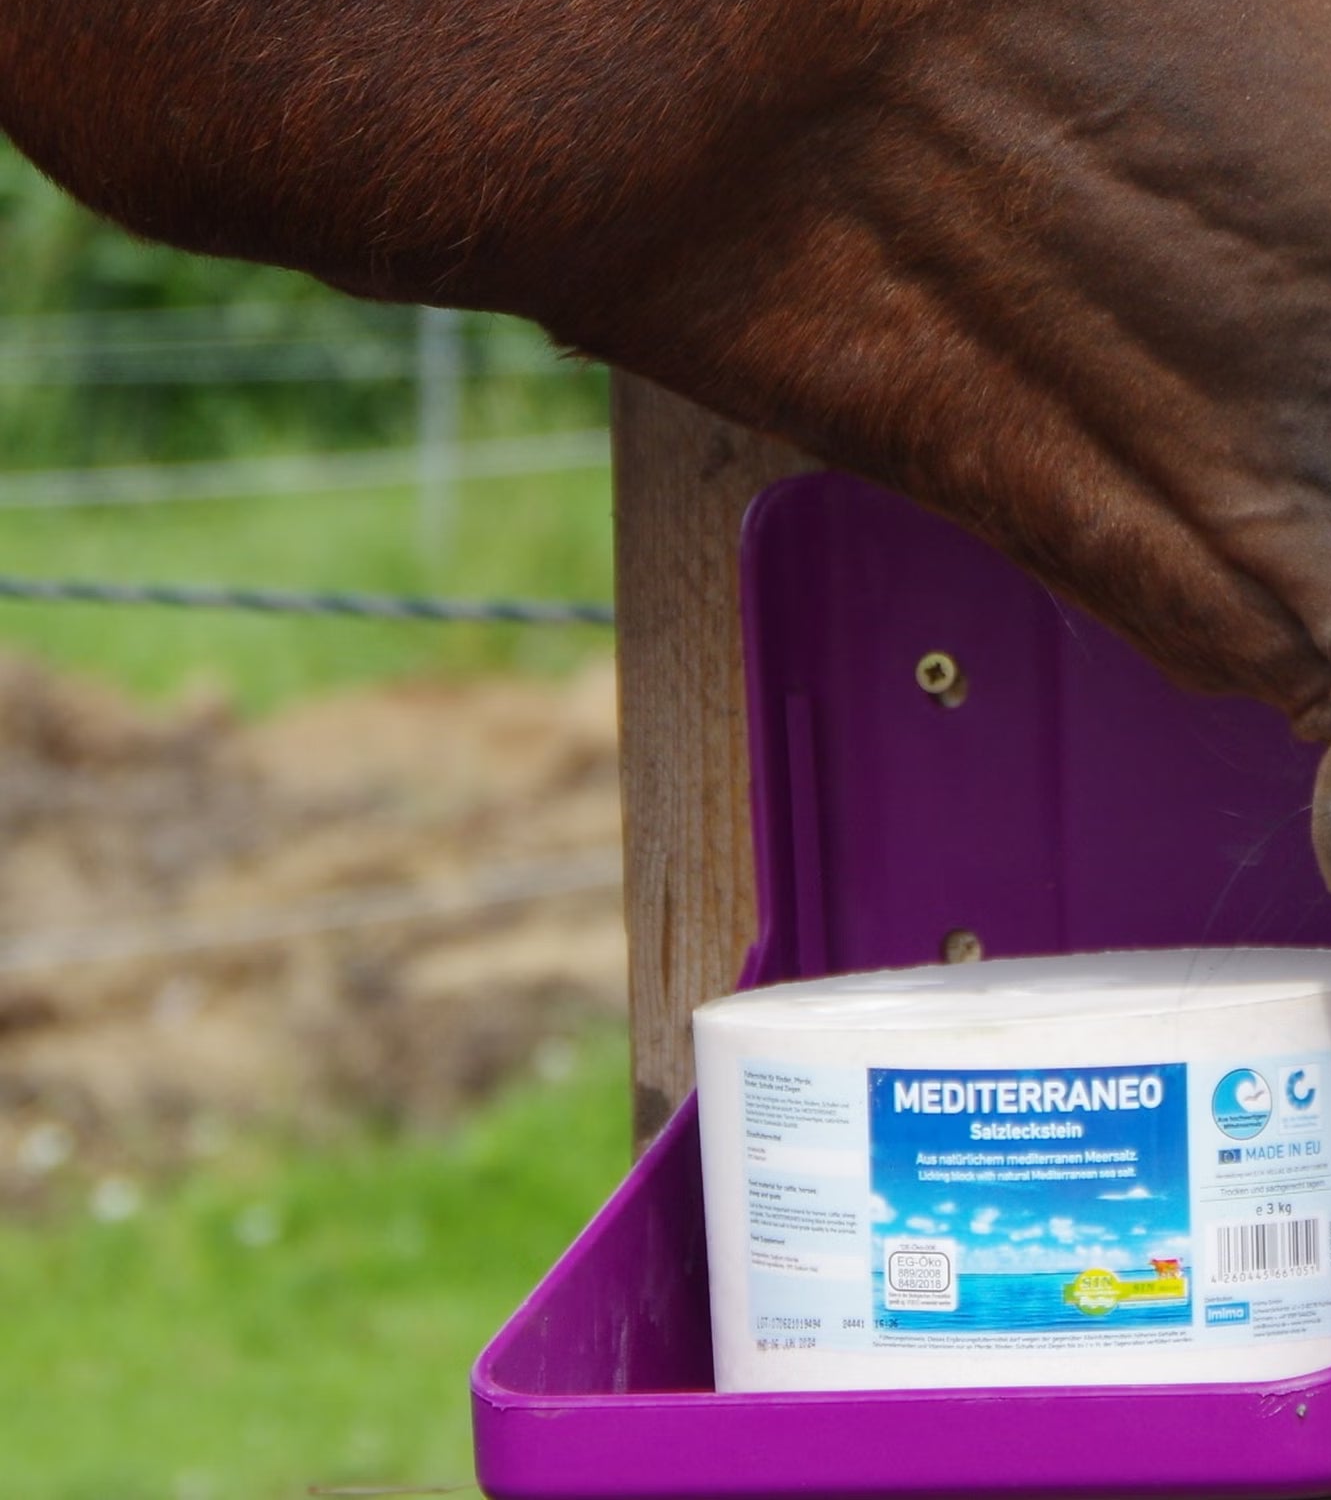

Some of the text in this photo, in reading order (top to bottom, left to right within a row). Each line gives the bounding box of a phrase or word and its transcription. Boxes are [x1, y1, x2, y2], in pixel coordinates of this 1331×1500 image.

[893, 1078, 1162, 1115] MEDITERRANEO
[970, 1121, 1083, 1141] Salzleckstein
[915, 1152, 937, 1166] Aus
[1006, 1151, 1083, 1166] mediterranen
[1084, 1150, 1139, 1164] Meersalz.
[1245, 1139, 1321, 1161] MADE IN EU
[917, 1170, 949, 1184] Licking
[950, 1170, 975, 1182] block
[975, 1170, 996, 1181] with
[996, 1170, 1030, 1181] natural
[1031, 1168, 1097, 1181] Mediterranean
[1098, 1169, 1116, 1179] sea
[1266, 1202, 1274, 1215] 3
[1278, 1201, 1292, 1216] kg
[896, 1255, 942, 1267] EG-Öko
